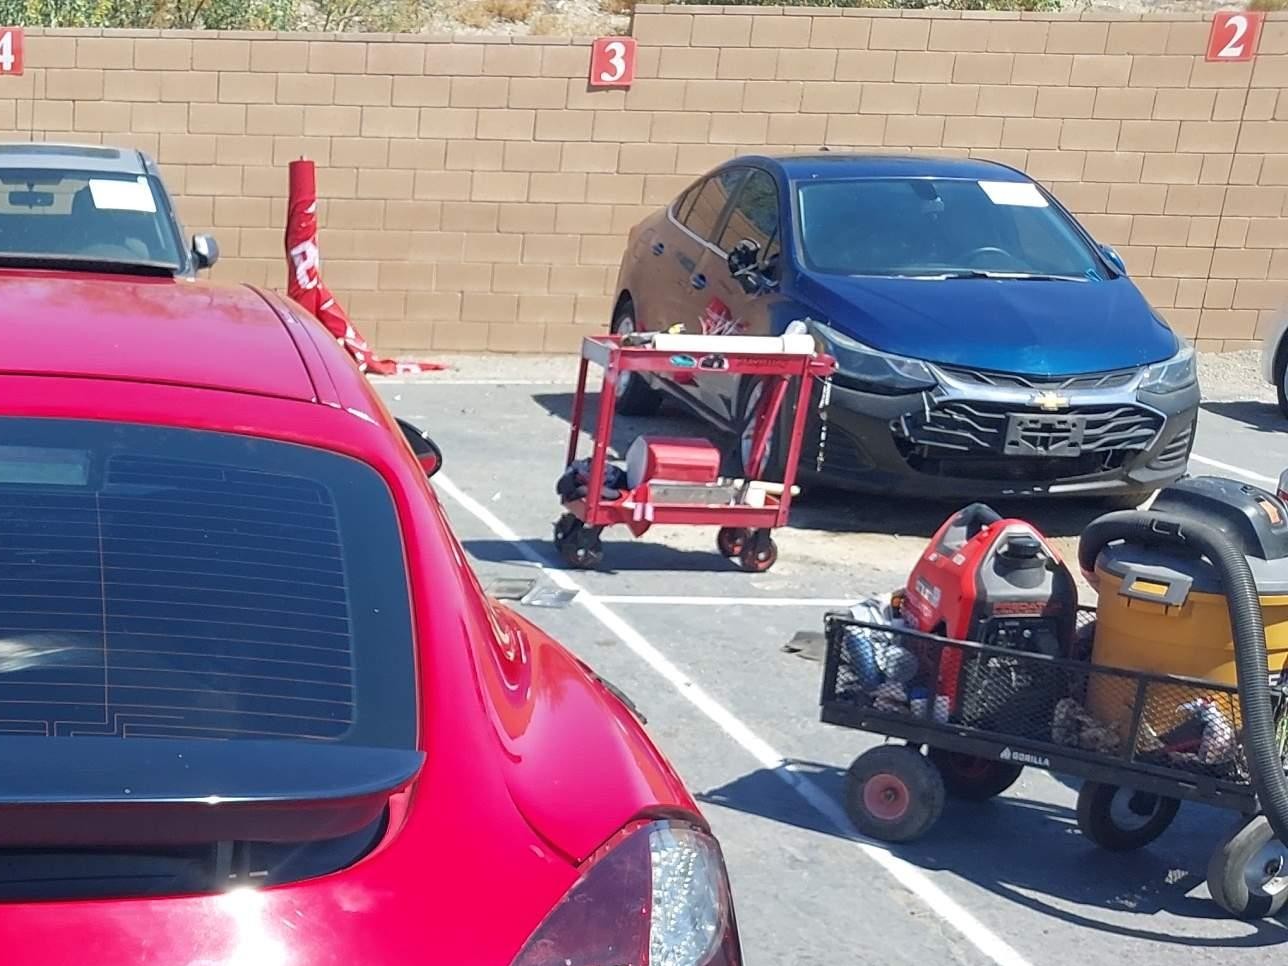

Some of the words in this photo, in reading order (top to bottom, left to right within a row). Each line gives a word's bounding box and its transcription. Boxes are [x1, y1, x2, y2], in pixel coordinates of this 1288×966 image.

[1217, 14, 1248, 57] 2
[600, 41, 626, 82] 3
[1012, 751, 1050, 766] GORILLA
